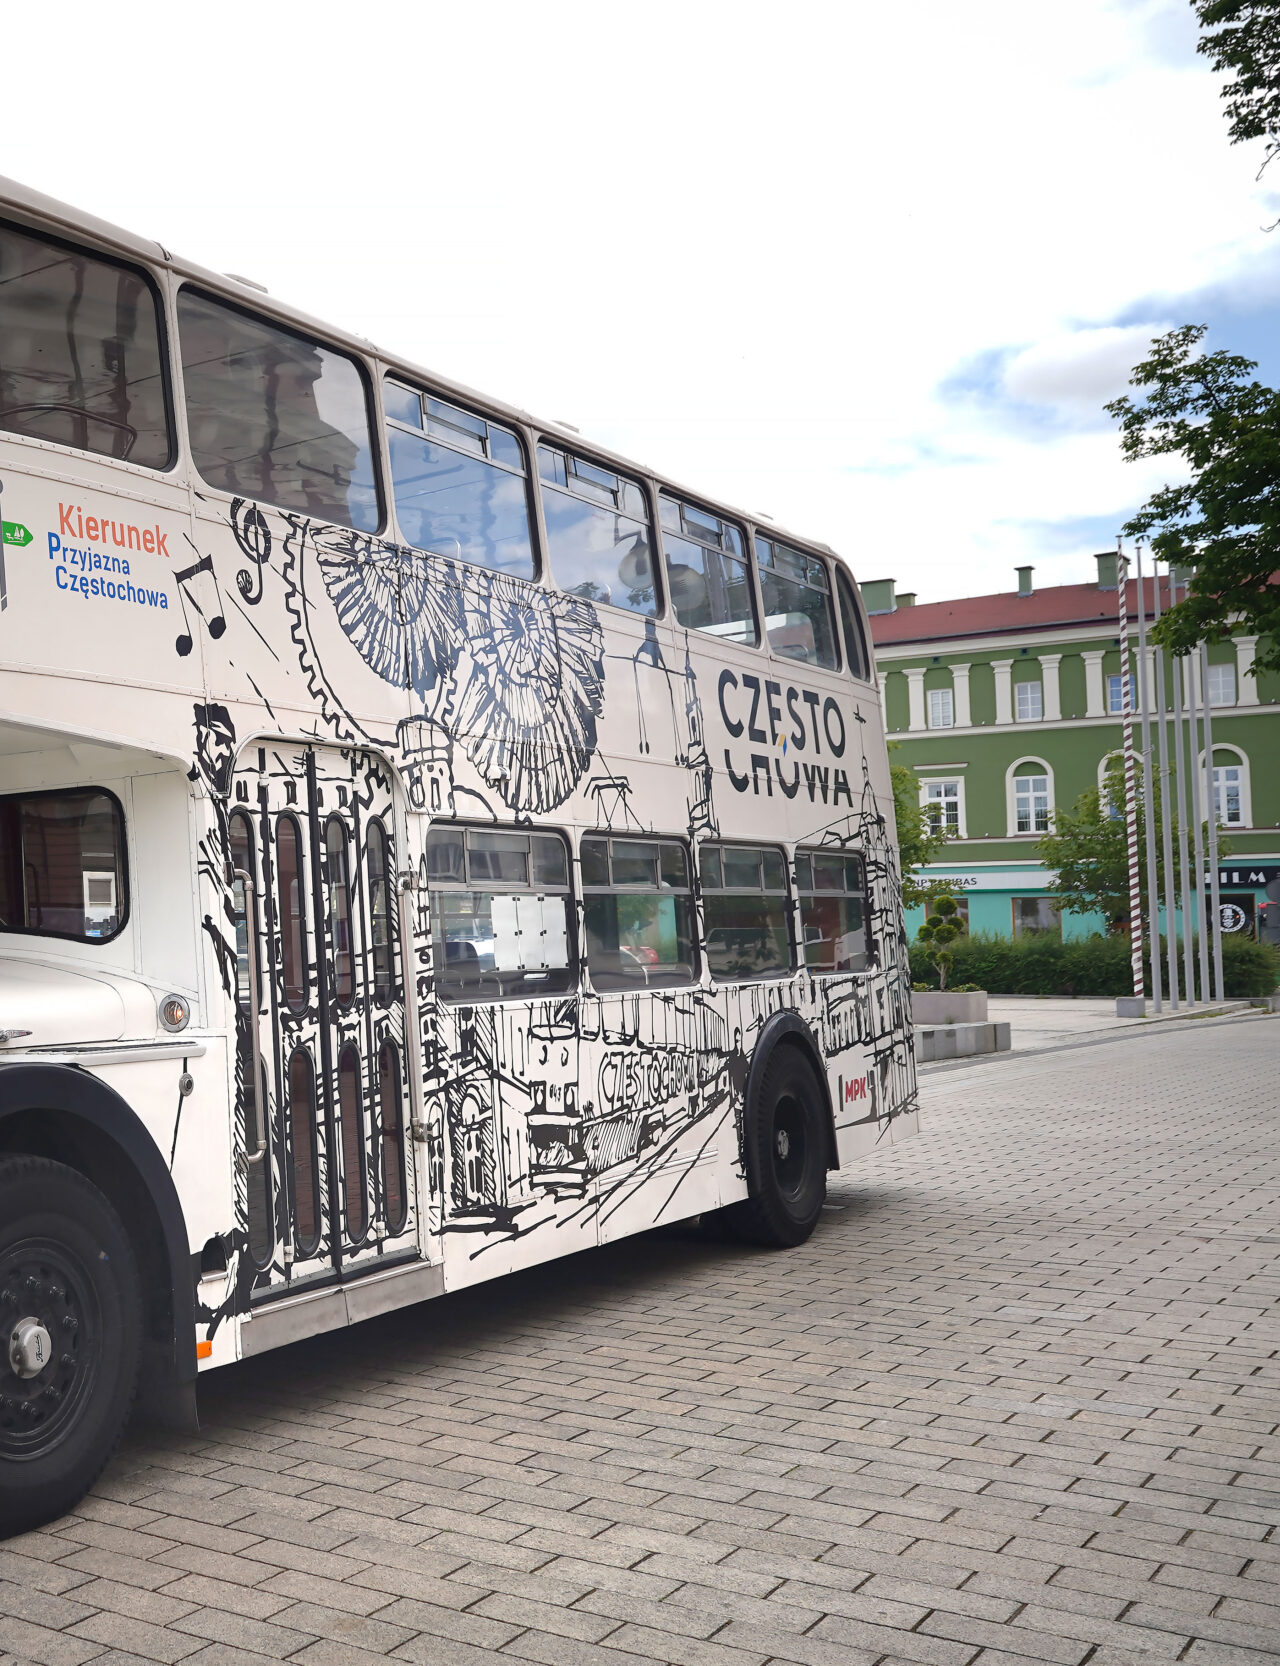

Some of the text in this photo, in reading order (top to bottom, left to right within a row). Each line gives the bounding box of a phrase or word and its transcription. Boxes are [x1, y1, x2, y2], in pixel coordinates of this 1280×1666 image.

[58, 502, 170, 558] Kierunek
[48, 531, 131, 576] Przyjazna
[55, 565, 169, 610] Częstochowa
[844, 1076, 867, 1104] MPK
